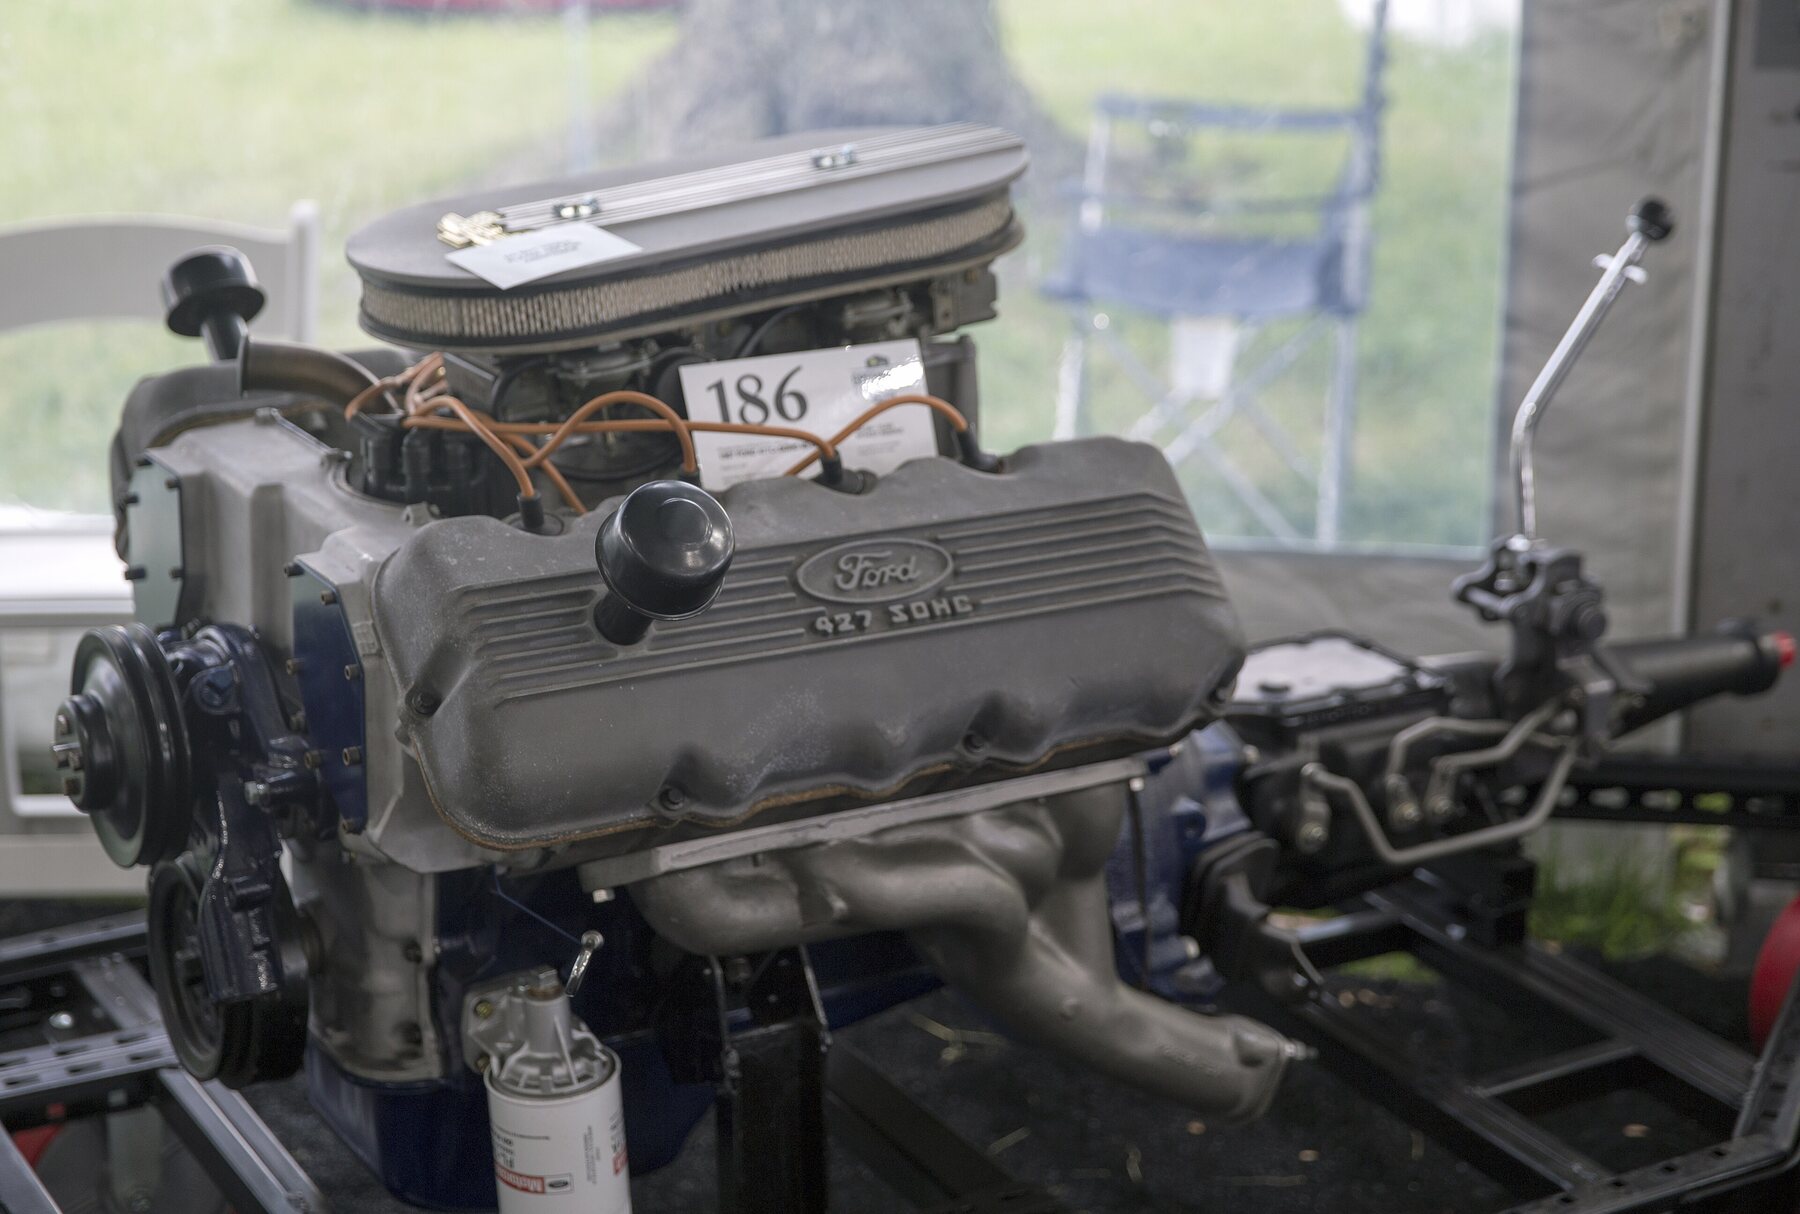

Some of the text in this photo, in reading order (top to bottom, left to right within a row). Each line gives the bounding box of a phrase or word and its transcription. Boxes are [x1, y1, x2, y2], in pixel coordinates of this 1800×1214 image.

[707, 365, 808, 425] 186
[834, 550, 922, 591] Ford
[815, 594, 974, 634] 427 SOHC
